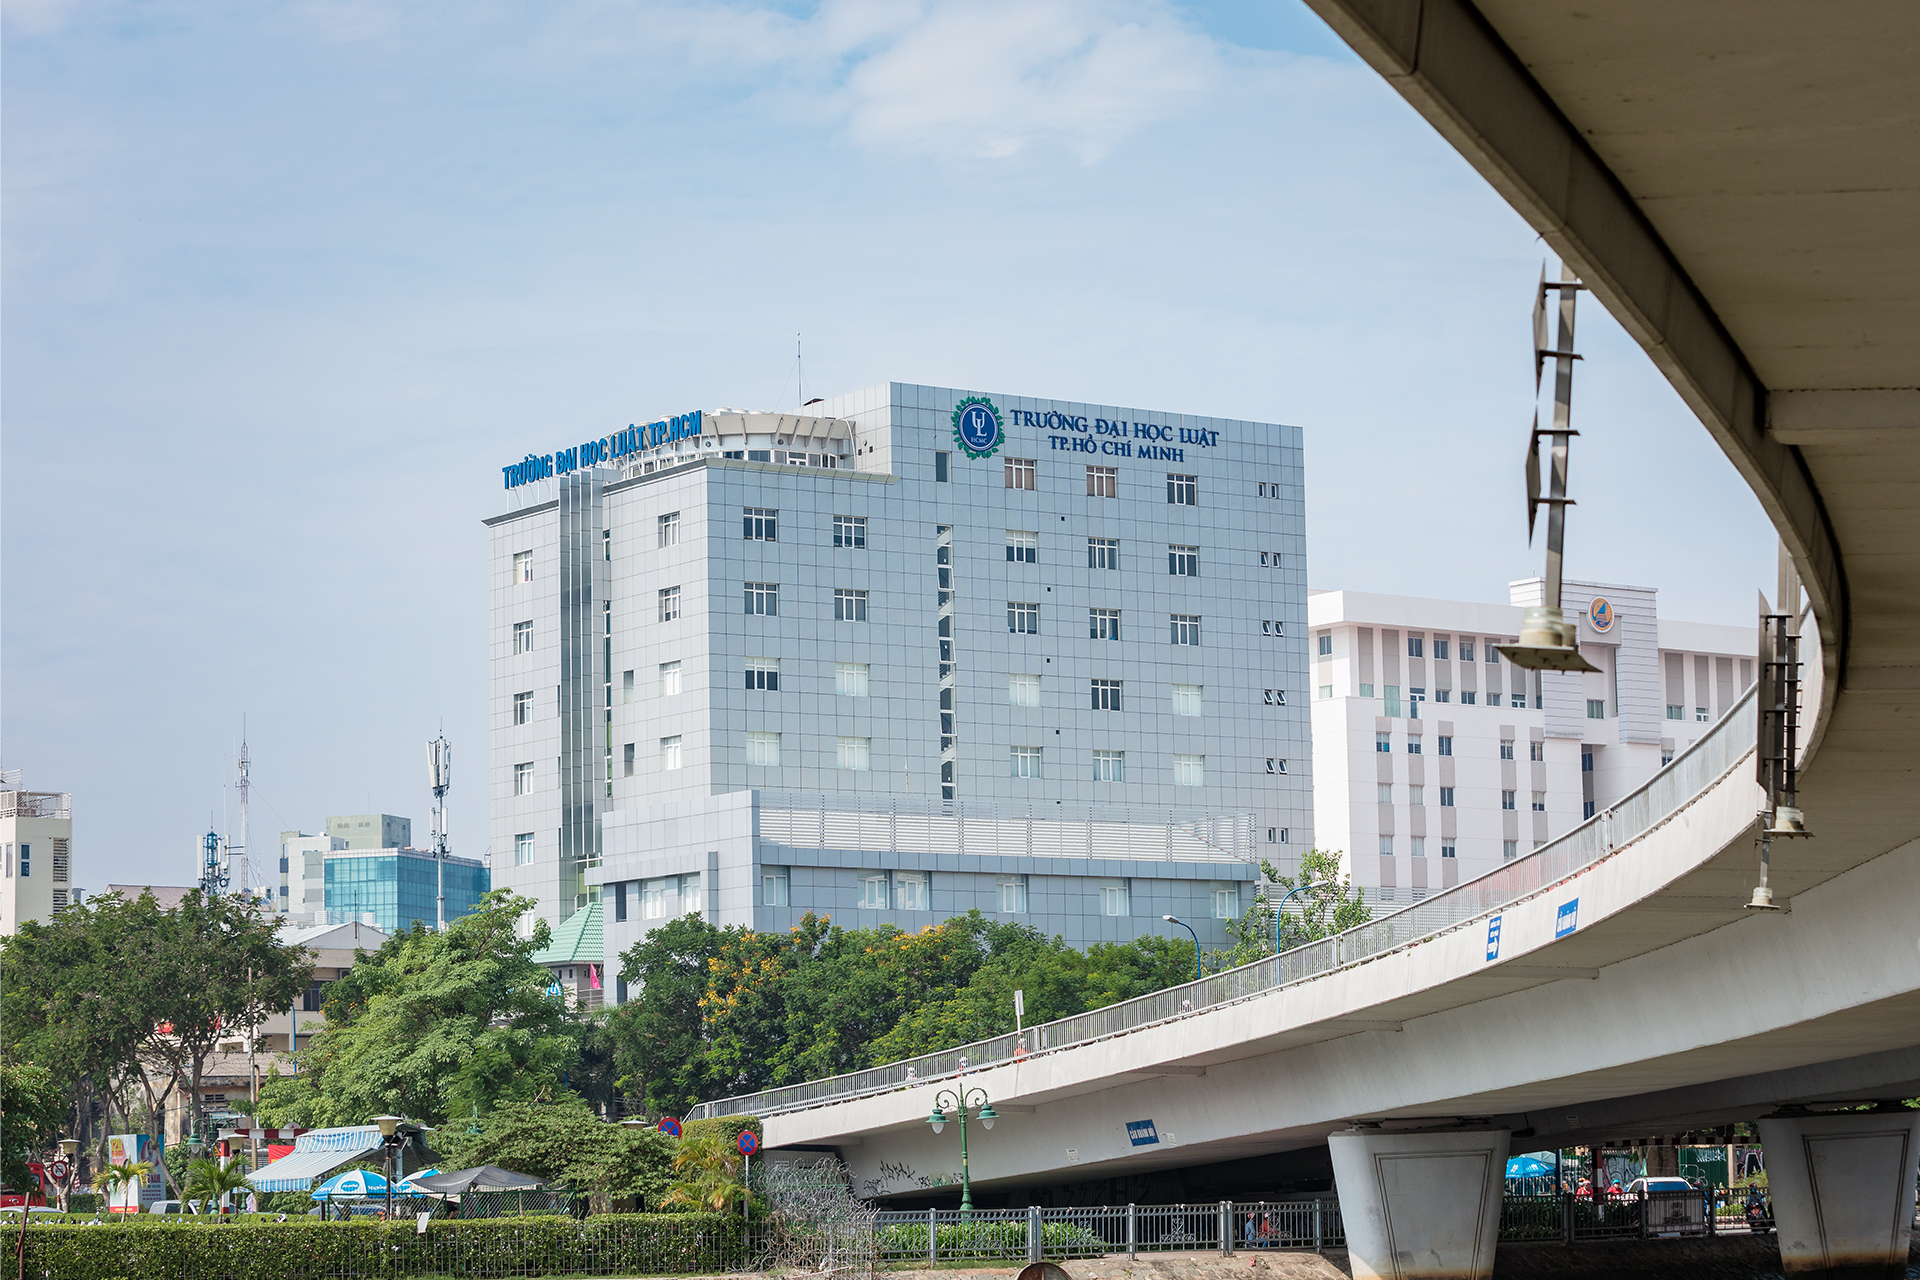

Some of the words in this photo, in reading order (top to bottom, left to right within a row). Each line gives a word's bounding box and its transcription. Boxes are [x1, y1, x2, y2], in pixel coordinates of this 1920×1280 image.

[1010, 409, 1088, 433] TRƯỜNG
[1095, 418, 1128, 439] ĐẠI
[1133, 422, 1174, 443] HỌC
[1179, 427, 1220, 448] LUẬT
[502, 453, 553, 489] TRƯỜNG
[556, 446, 578, 476] ĐẠI
[610, 423, 646, 459] LUẬT
[648, 410, 702, 448] TP.HCM
[1101, 440, 1132, 457] CHÍ
[1137, 444, 1185, 463] MINH
